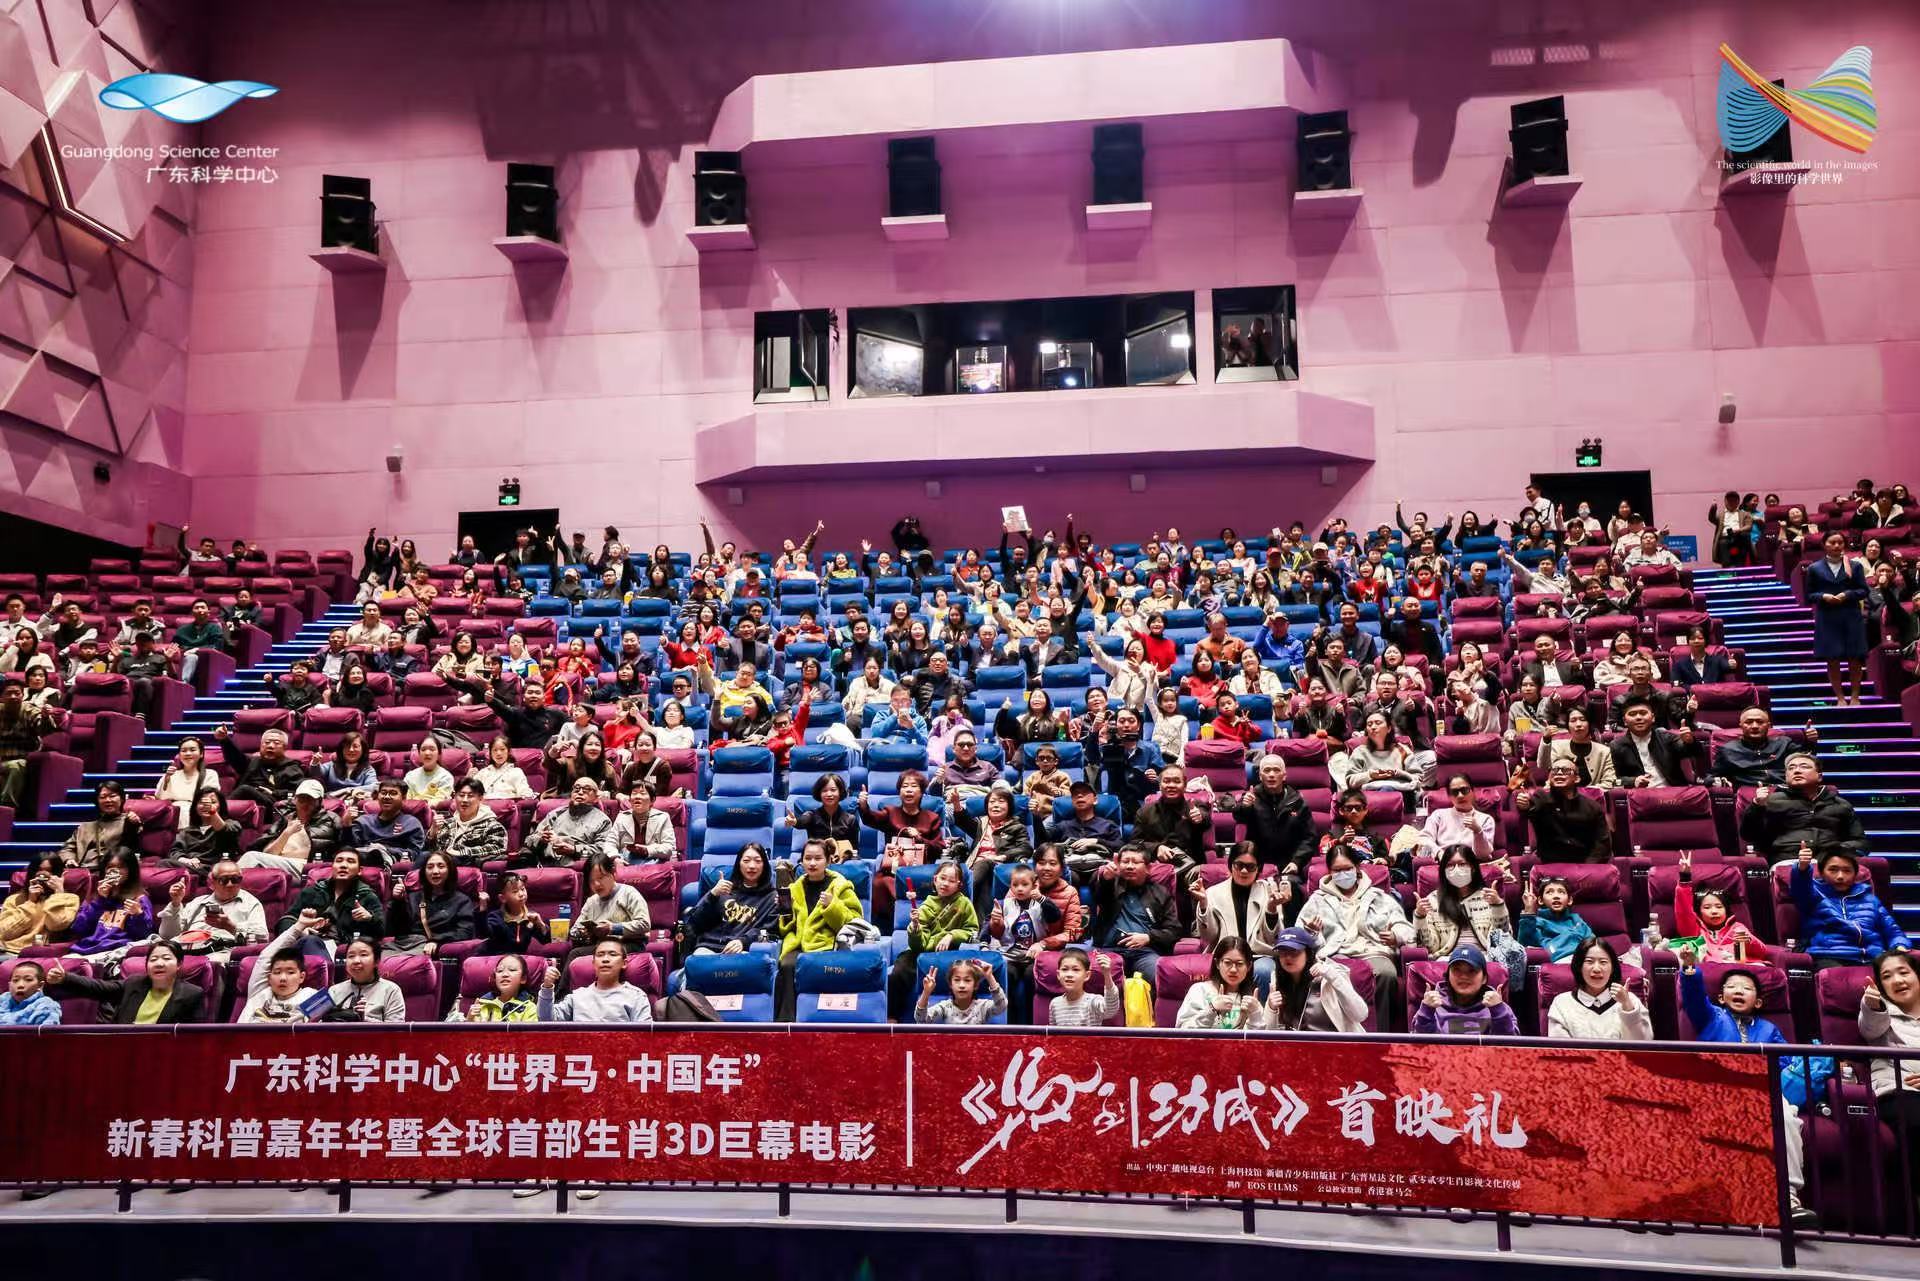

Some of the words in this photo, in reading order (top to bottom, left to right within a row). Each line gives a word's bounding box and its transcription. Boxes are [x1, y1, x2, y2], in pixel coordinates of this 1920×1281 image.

[225, 1053, 761, 1094] 广东科学中心“世界马·中国年”
[1327, 1081, 1528, 1149] 首映礼
[108, 1118, 875, 1162] 新春科普嘉年华暨全球首部生肖3D巨幕电影
[1145, 1162, 1215, 1175] 中央广播电视总台
[1220, 1167, 1262, 1178] 上海科技馆
[1266, 1168, 1337, 1180] 新疆青少年出版社
[1247, 1182, 1265, 1191] EOS
[1267, 1182, 1298, 1192] FILMS
[1367, 1187, 1413, 1197] 香港赛马会
